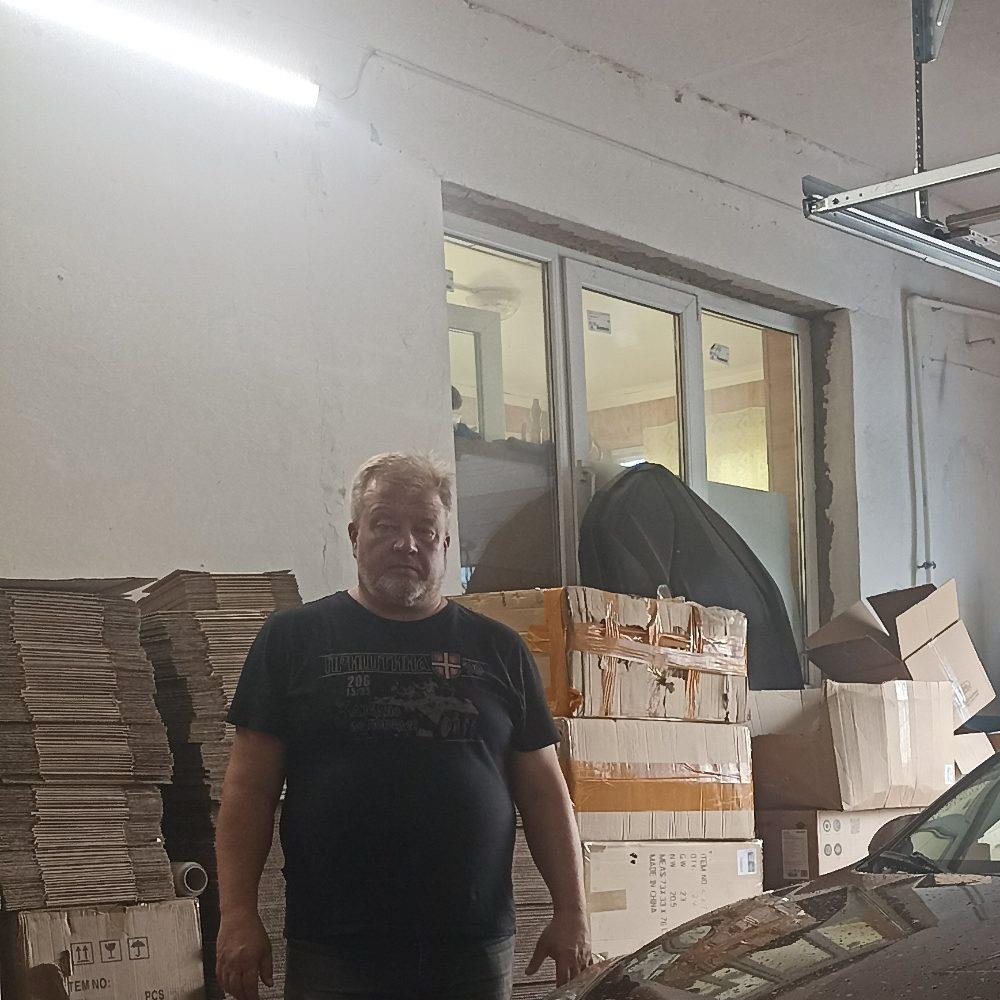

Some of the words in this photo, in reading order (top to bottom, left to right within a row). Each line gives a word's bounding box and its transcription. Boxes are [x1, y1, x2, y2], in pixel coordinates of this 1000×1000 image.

[649, 853, 657, 877] MADE
[649, 879, 657, 888] IN
[649, 890, 657, 914] CHINA
[68, 980, 90, 993] TEM
[144, 989, 165, 1000] PCS
